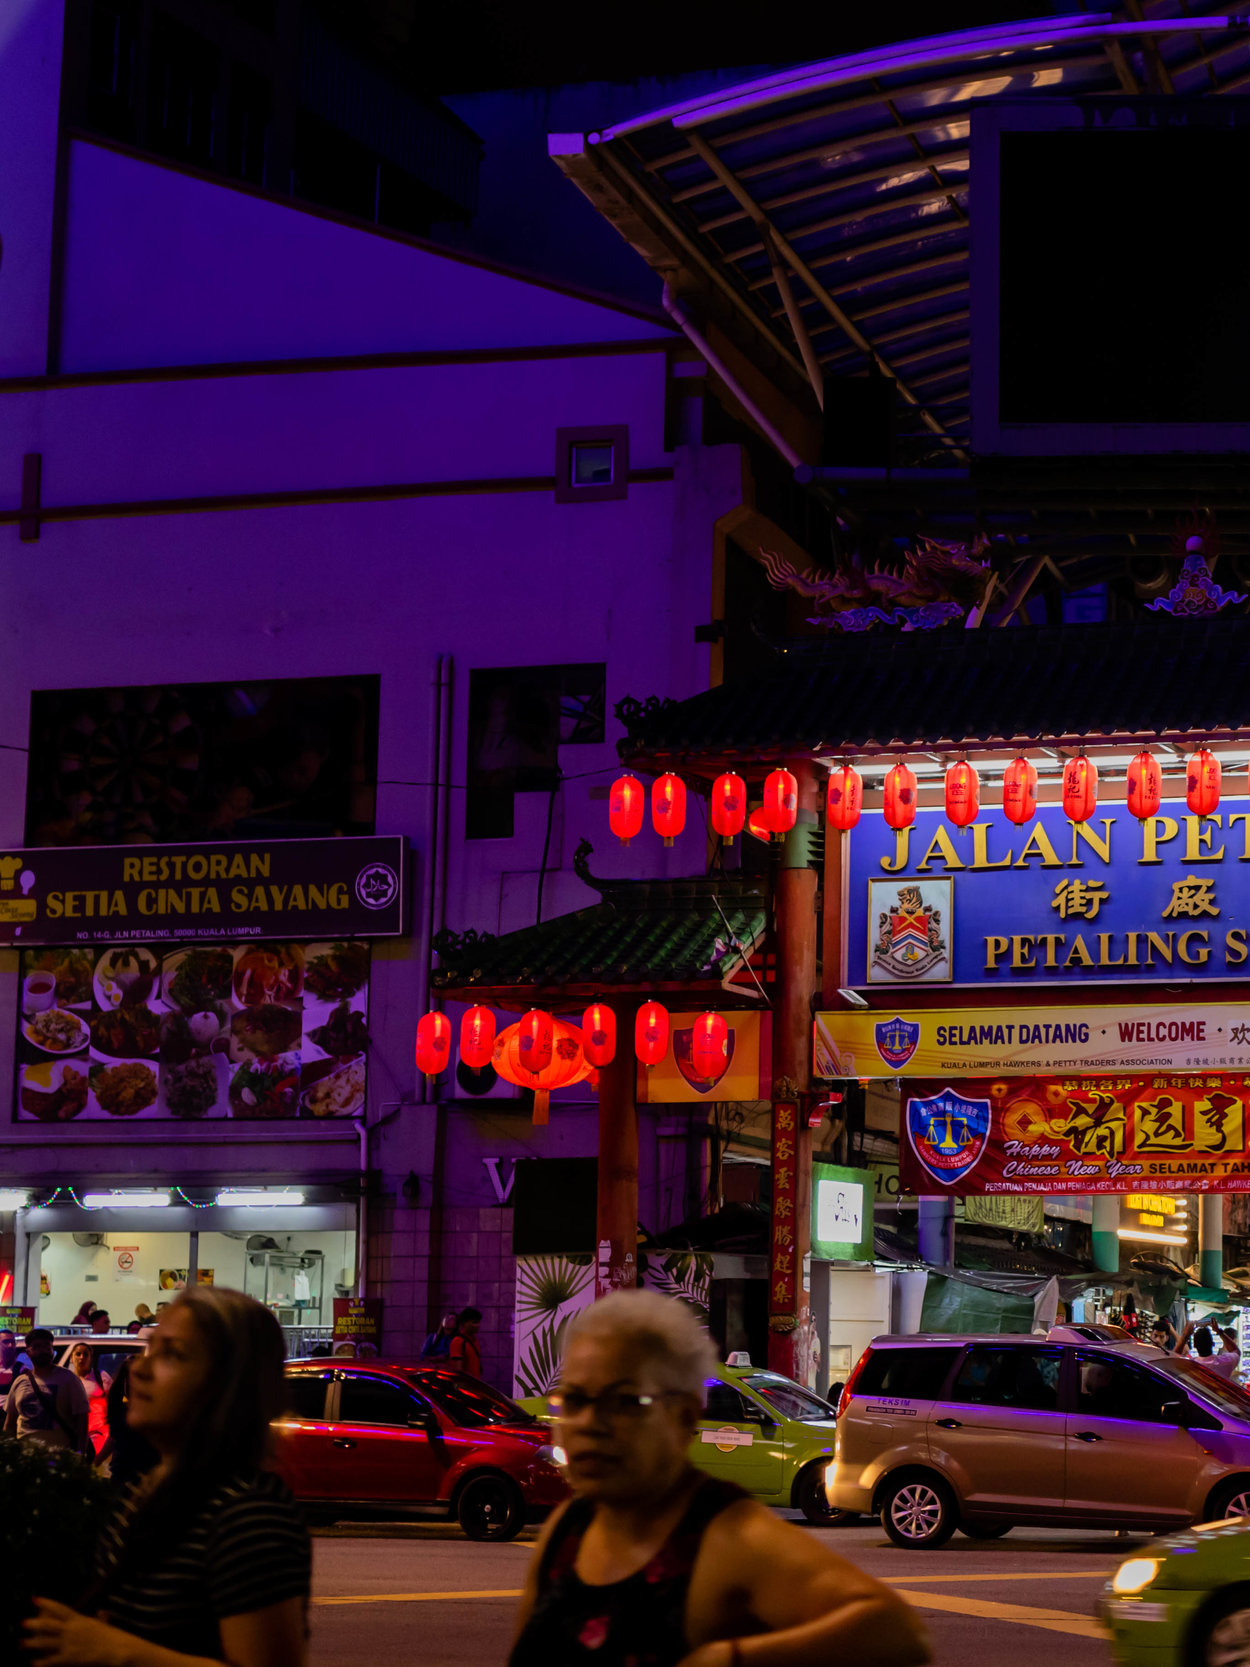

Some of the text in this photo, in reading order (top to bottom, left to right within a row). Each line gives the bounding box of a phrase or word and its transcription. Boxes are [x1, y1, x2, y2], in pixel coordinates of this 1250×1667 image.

[880, 818, 1117, 872] JALAN
[123, 852, 271, 883] RESTORAN
[45, 889, 128, 919] SETIA
[137, 886, 221, 916] CINTA
[230, 882, 349, 913] SAYANG
[197, 928, 226, 938] KUALA
[984, 930, 1212, 969] PETALING
[936, 1025, 1015, 1046] SELAMAT
[1019, 1023, 1090, 1044] DATANG
[1118, 1021, 1206, 1042] WELCOME
[941, 1061, 967, 1069] KUALA
[969, 1061, 1000, 1069] LUMPUR
[1120, 1058, 1173, 1066] ASSOCIATION
[1003, 1140, 1061, 1159] Happy
[1002, 1161, 1059, 1178] Chinese
[1065, 1160, 1100, 1176] New
[1105, 1160, 1143, 1178] Year
[1150, 1163, 1216, 1174] SELAMAT
[985, 1183, 1023, 1192] PERSATUAN
[1024, 1182, 1052, 1191] PENJAJA
[1053, 1182, 1066, 1191] DAN
[1067, 1182, 1096, 1190] PENIAGA
